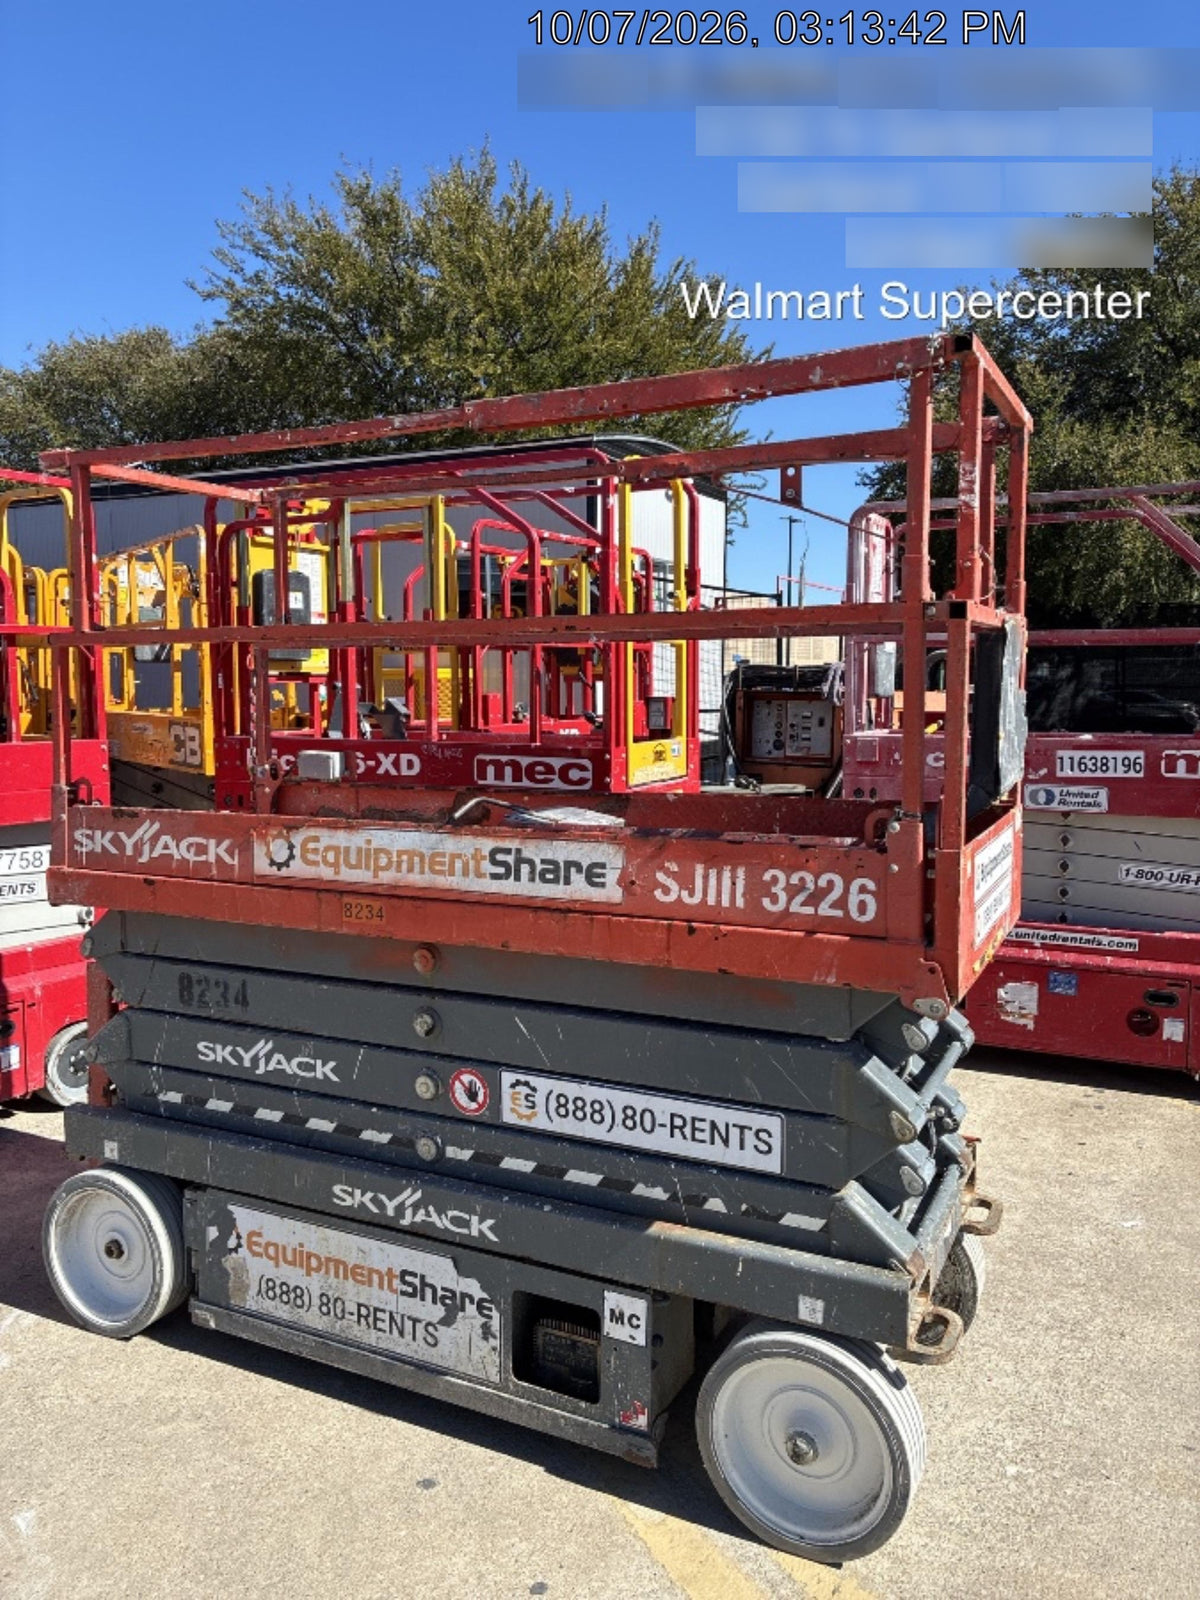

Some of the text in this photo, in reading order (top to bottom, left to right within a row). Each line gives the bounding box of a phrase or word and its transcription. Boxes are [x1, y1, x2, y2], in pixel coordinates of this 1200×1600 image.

[475, 755, 593, 790] mec
[1057, 756, 1143, 774] 11638196
[1057, 798, 1102, 808] Rentals
[1059, 788, 1100, 799] United
[0, 850, 44, 870] 758
[74, 819, 236, 865] SKYJACK
[299, 835, 607, 888] EquipmentShare
[343, 902, 385, 922] 8234
[653, 861, 878, 923] SJIII 3226
[178, 971, 250, 1013] 8234
[196, 1038, 341, 1083] SKYJACK
[331, 1183, 500, 1242] SKYJACK
[246, 1229, 494, 1320] EquipmentShare
[256, 1274, 440, 1348] (888) 80-RENTS
[609, 1307, 641, 1330] MC
